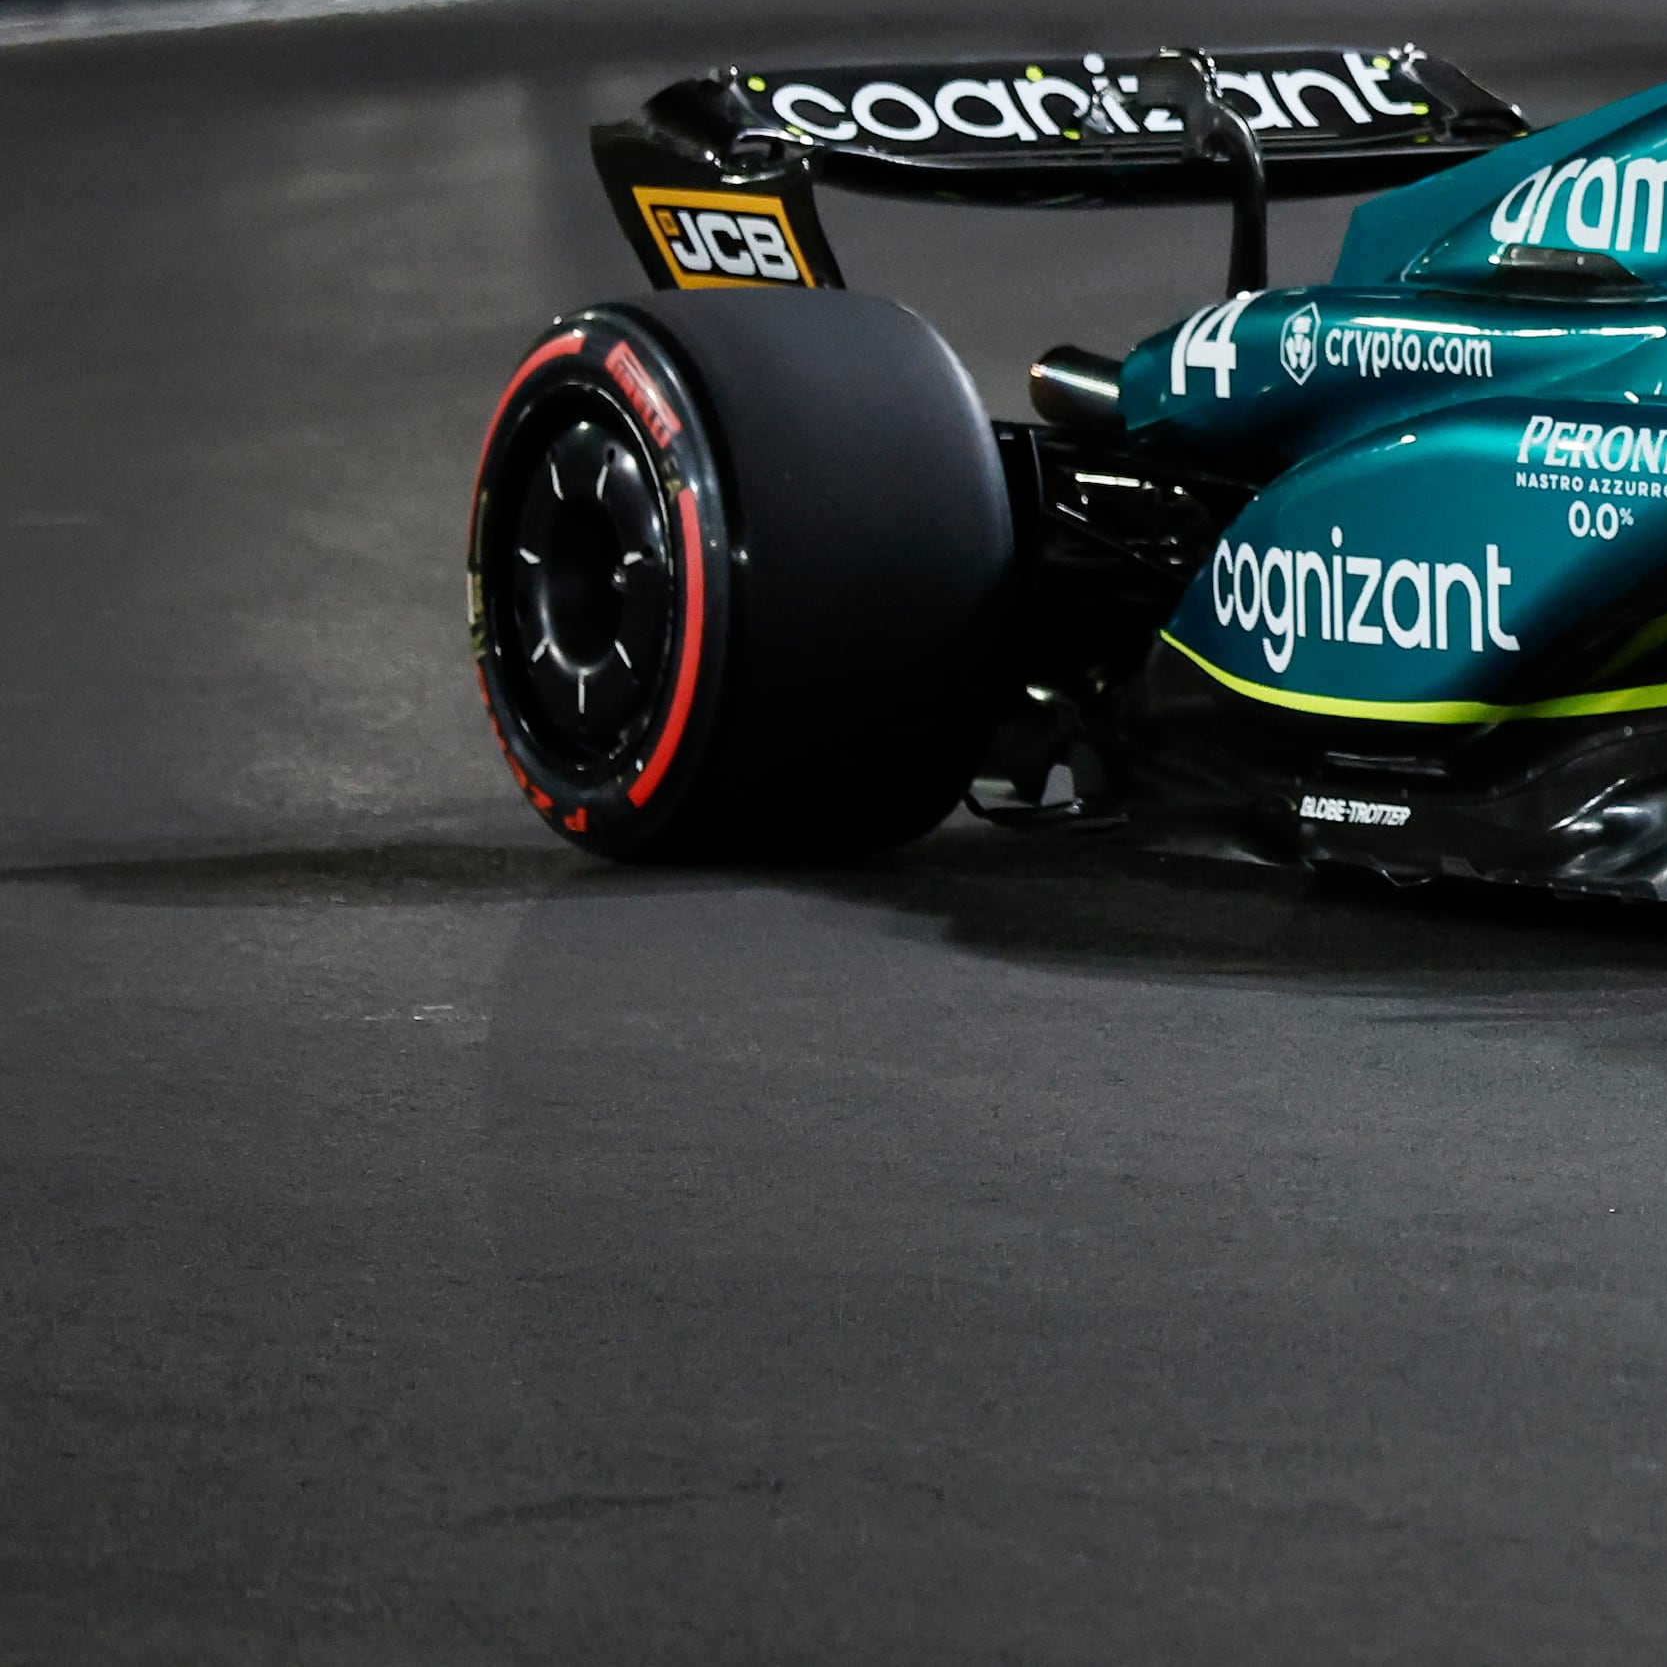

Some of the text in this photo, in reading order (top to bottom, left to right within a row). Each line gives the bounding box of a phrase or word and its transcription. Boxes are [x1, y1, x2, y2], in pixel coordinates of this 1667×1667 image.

[671, 210, 799, 281] JCB
[1172, 295, 1236, 398] 14
[1325, 326, 1493, 379] crypto.com
[1516, 472, 1584, 492] NASTRO
[1568, 500, 1634, 540] 0.0%
[1212, 527, 1520, 674] cognizant
